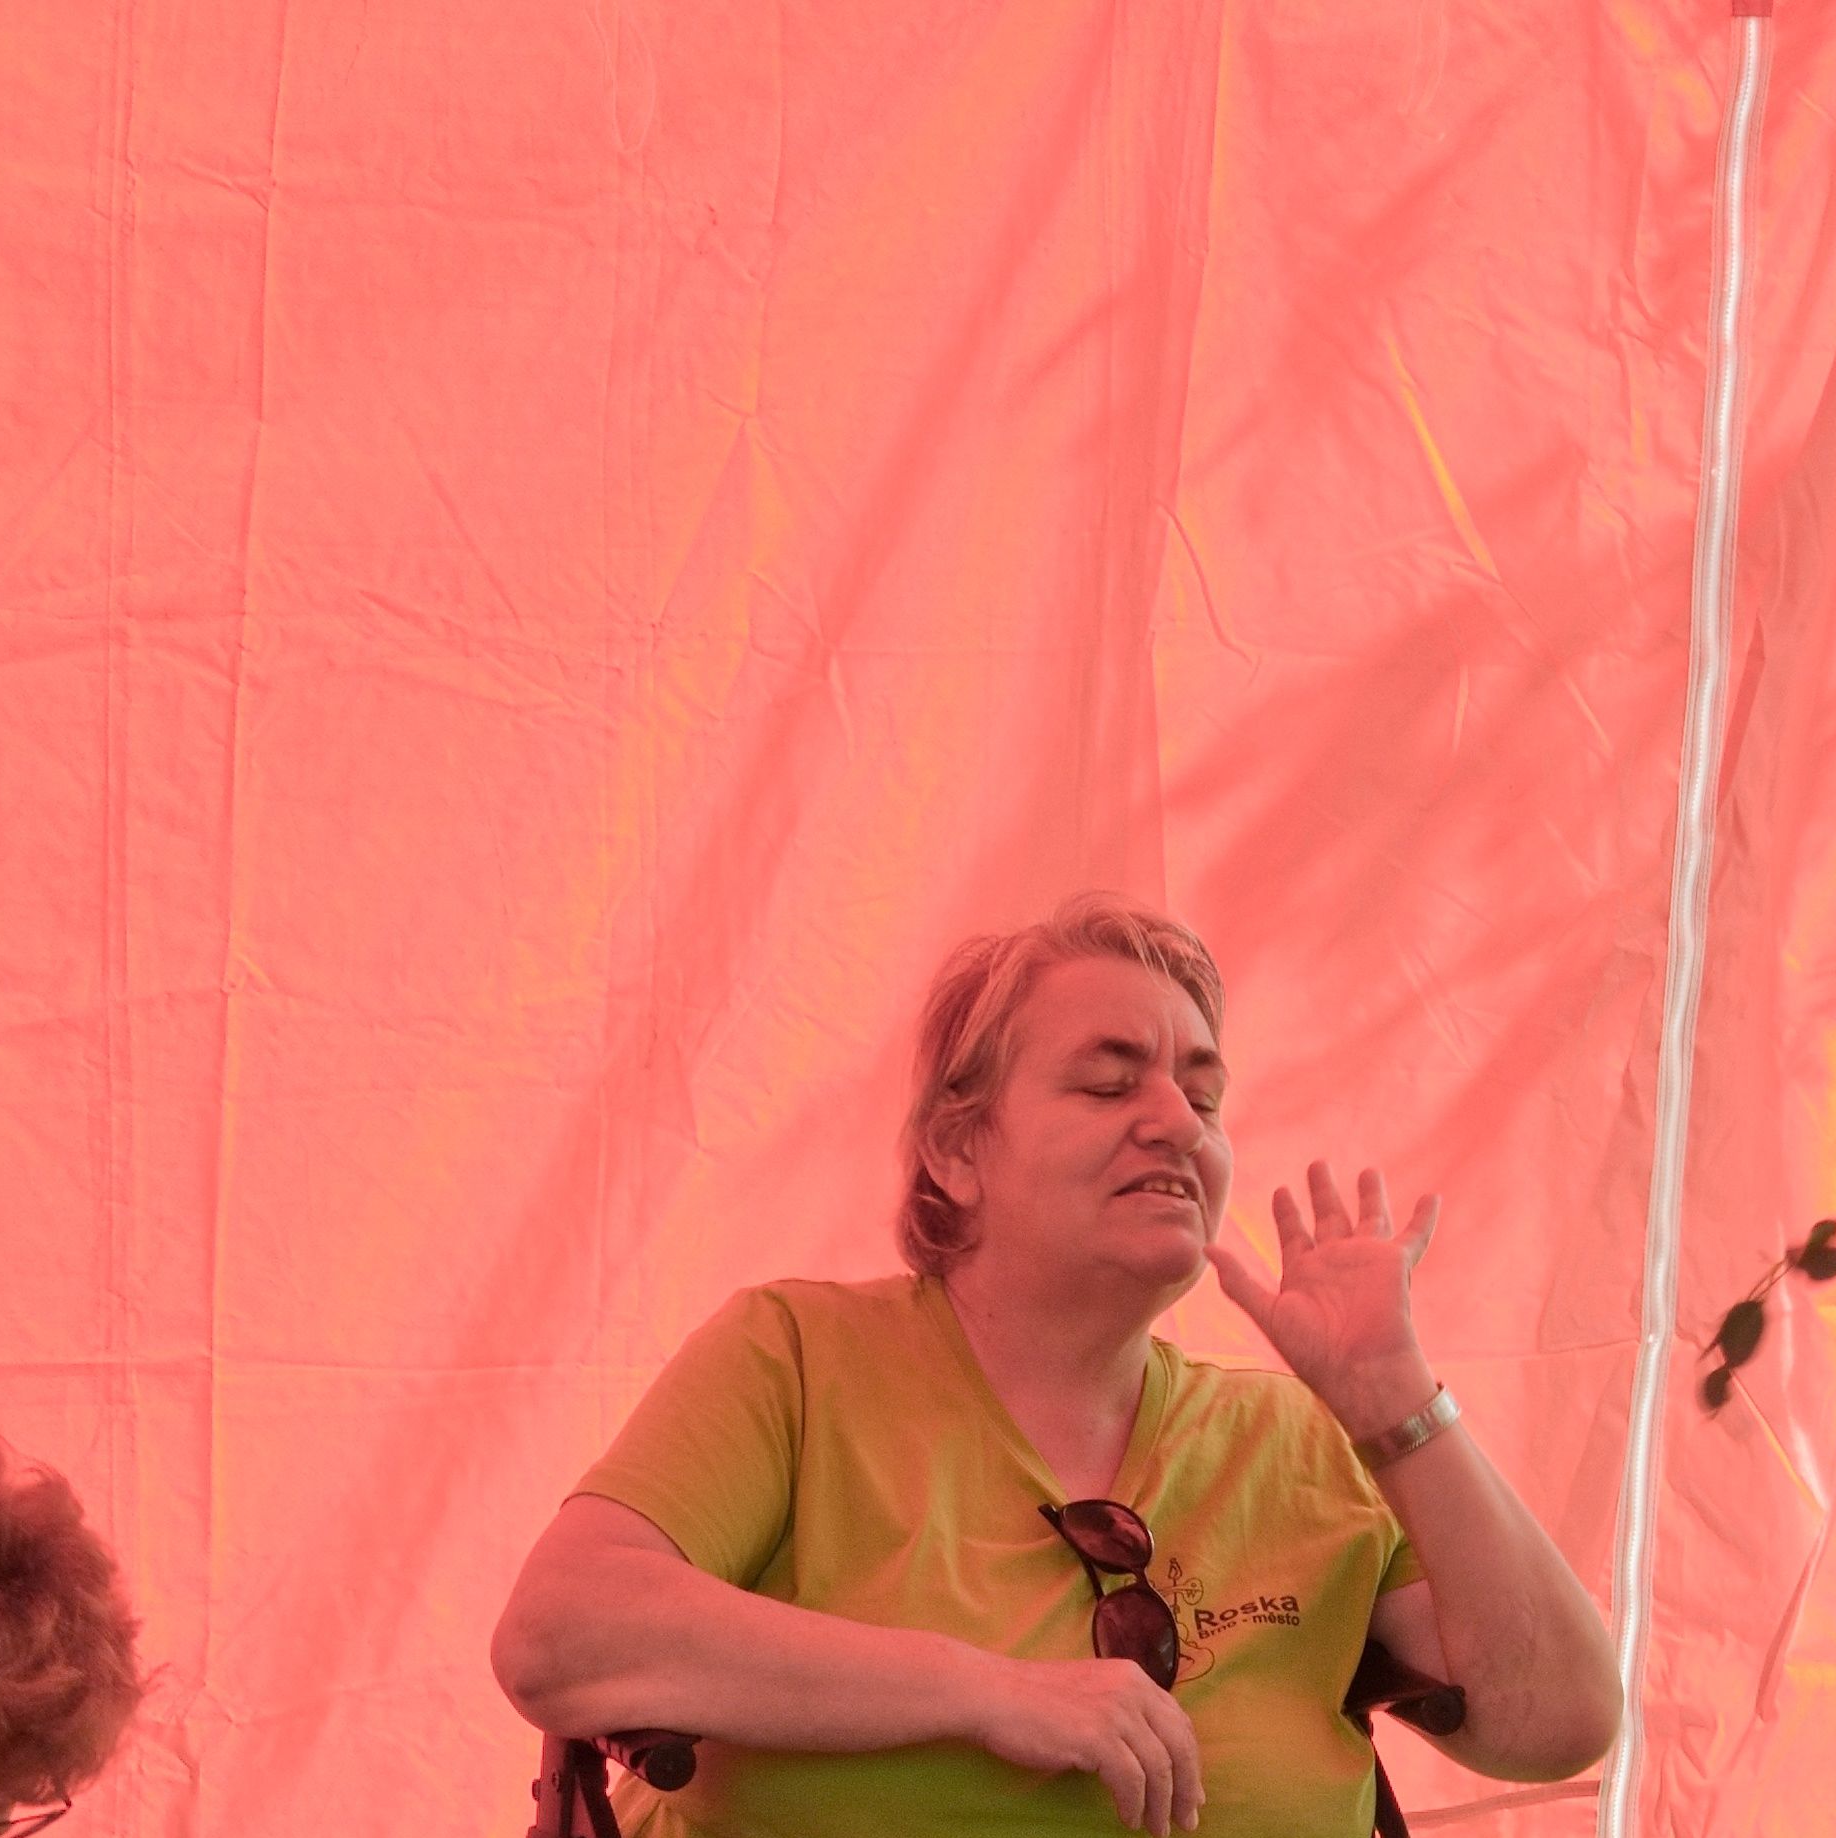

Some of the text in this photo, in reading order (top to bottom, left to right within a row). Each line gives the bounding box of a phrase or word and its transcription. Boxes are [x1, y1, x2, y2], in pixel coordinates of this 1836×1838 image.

[1194, 1596, 1300, 1630] Roska
[1198, 1620, 1237, 1640] Brno
[1252, 1611, 1301, 1627] město
